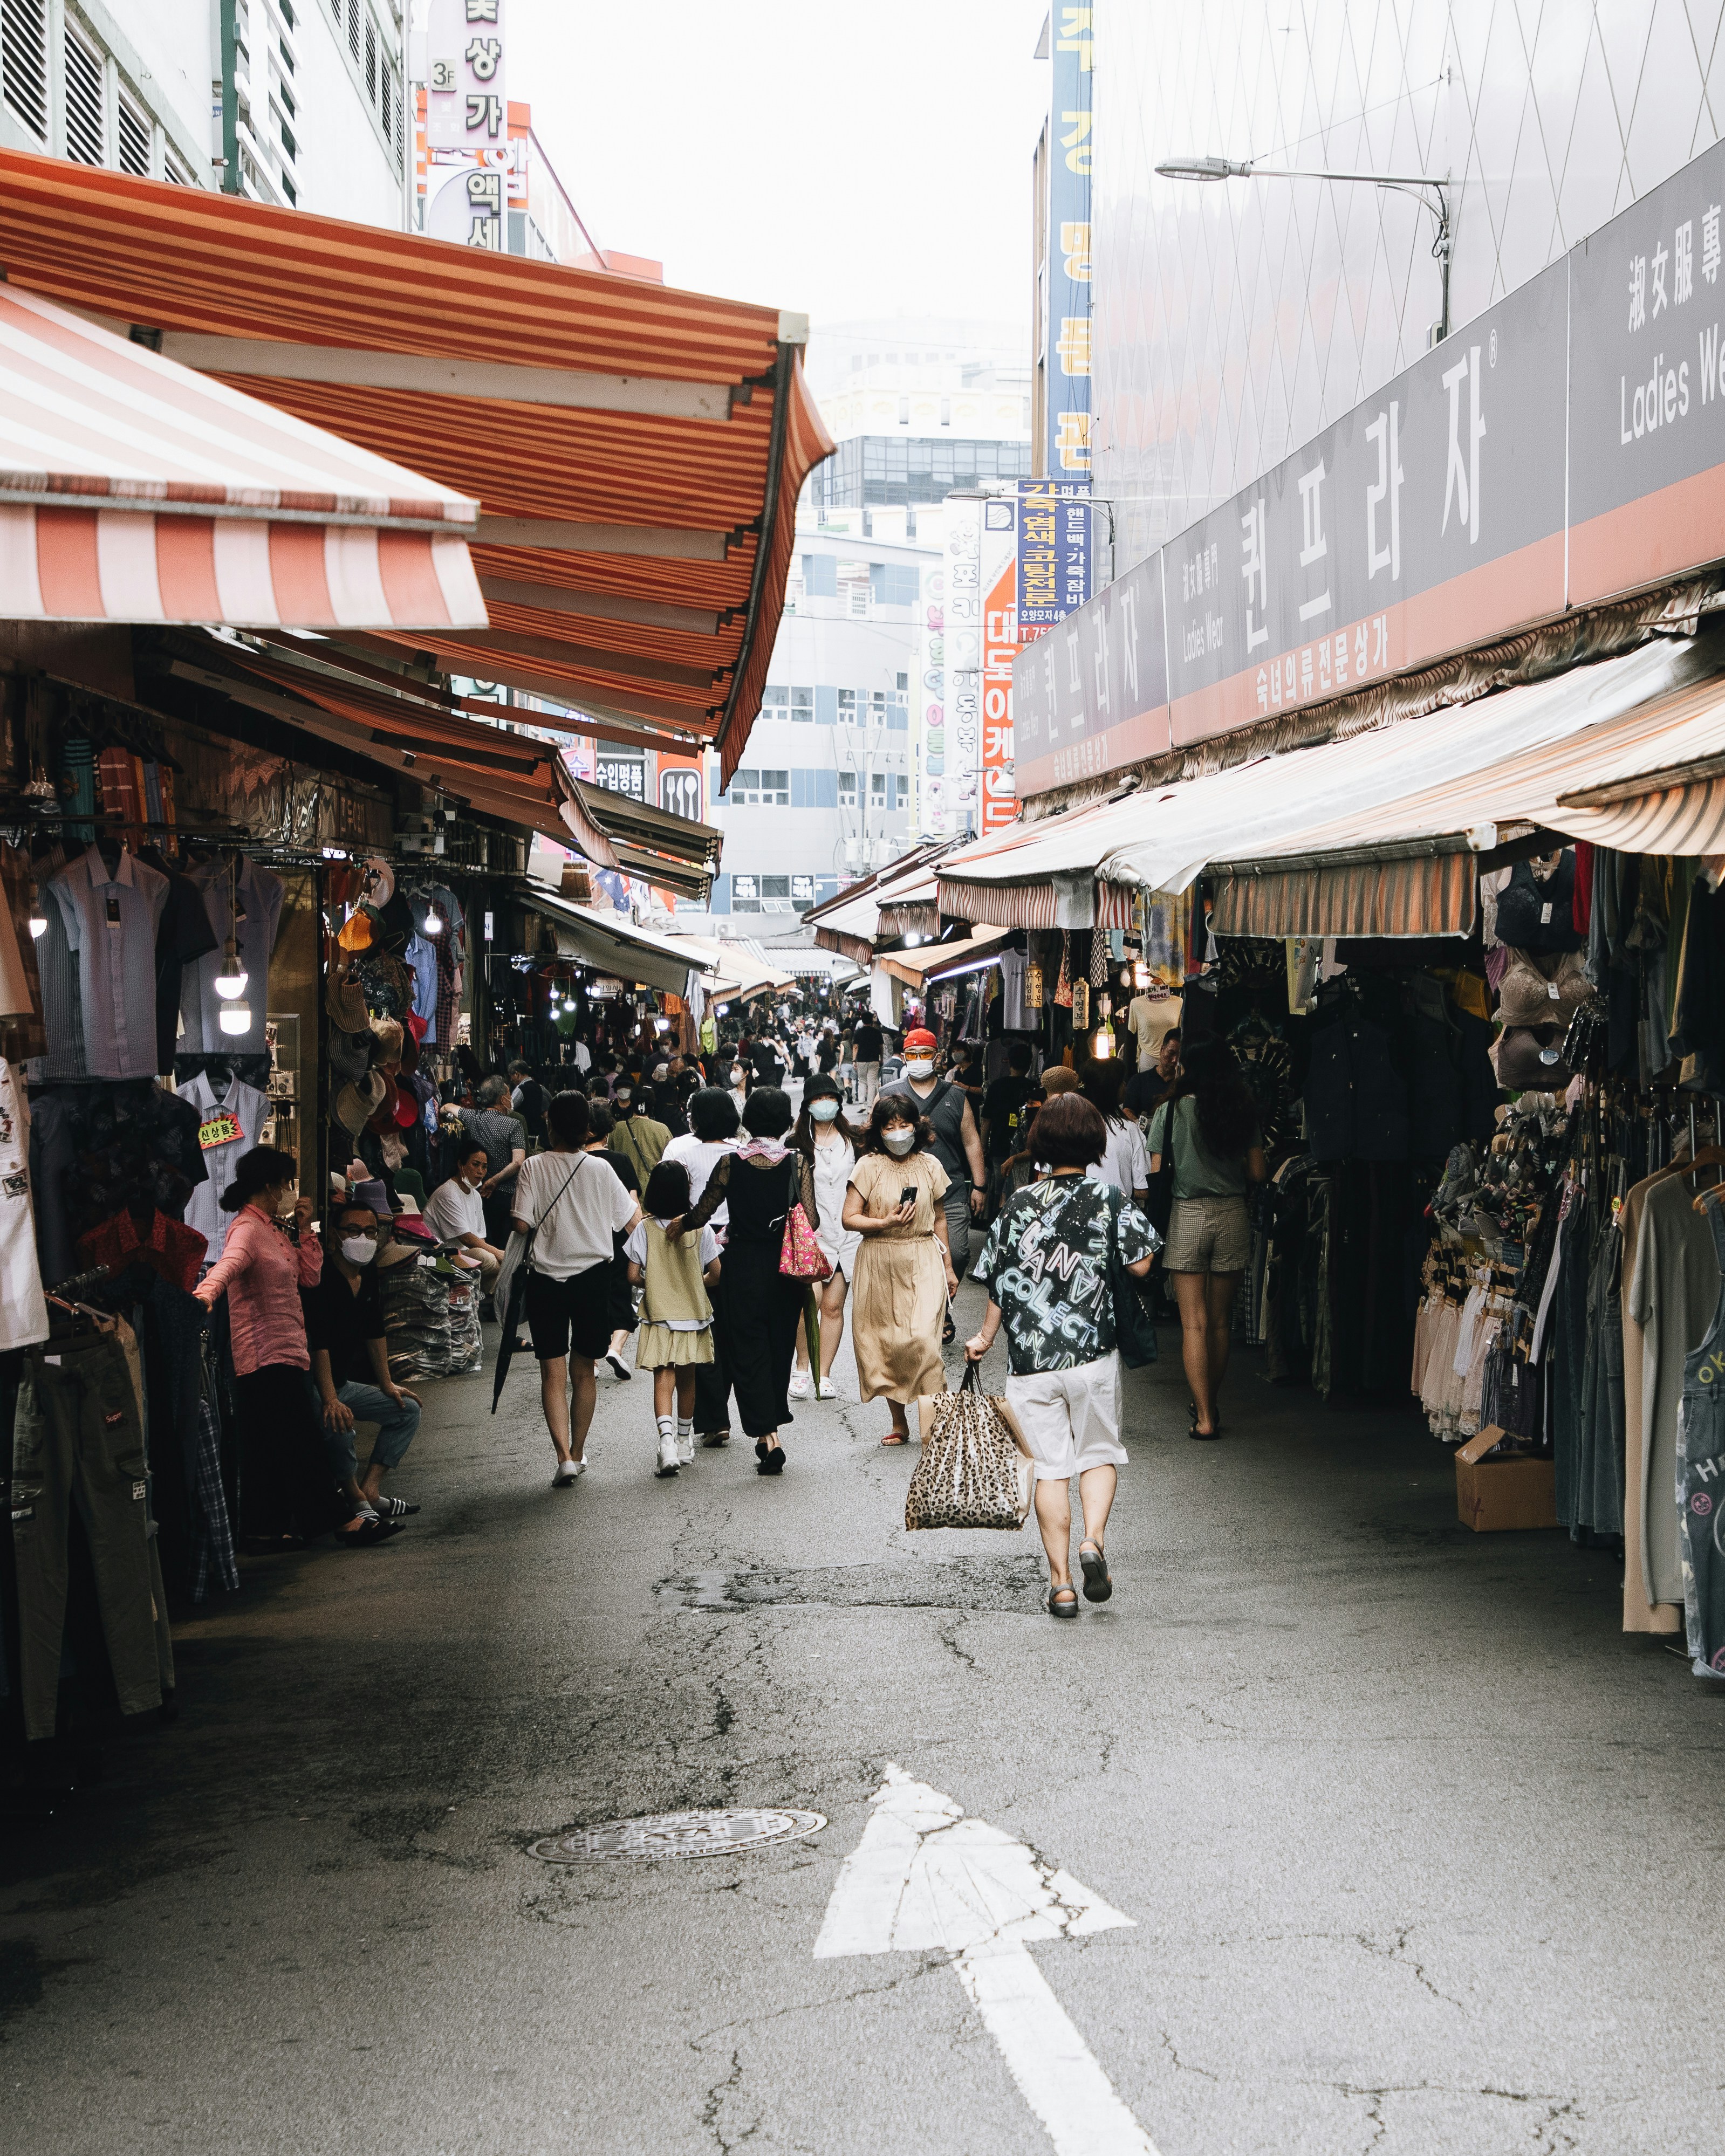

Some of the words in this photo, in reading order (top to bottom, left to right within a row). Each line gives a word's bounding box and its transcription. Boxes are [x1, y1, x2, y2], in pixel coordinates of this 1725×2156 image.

[433, 62, 454, 85] 3F
[1621, 353, 1689, 445] Ladies
[1241, 346, 1487, 654] 퀸프라자
[1021, 610, 1053, 622] 오양모자
[1183, 618, 1204, 663] Ladies
[1206, 610, 1223, 651] Wear
[1256, 614, 1388, 712] 숙녀의류전문상가
[596, 763, 643, 792] 수입명품
[1074, 986, 1086, 1024] 수영복
[202, 1123, 230, 1142] 신상품
